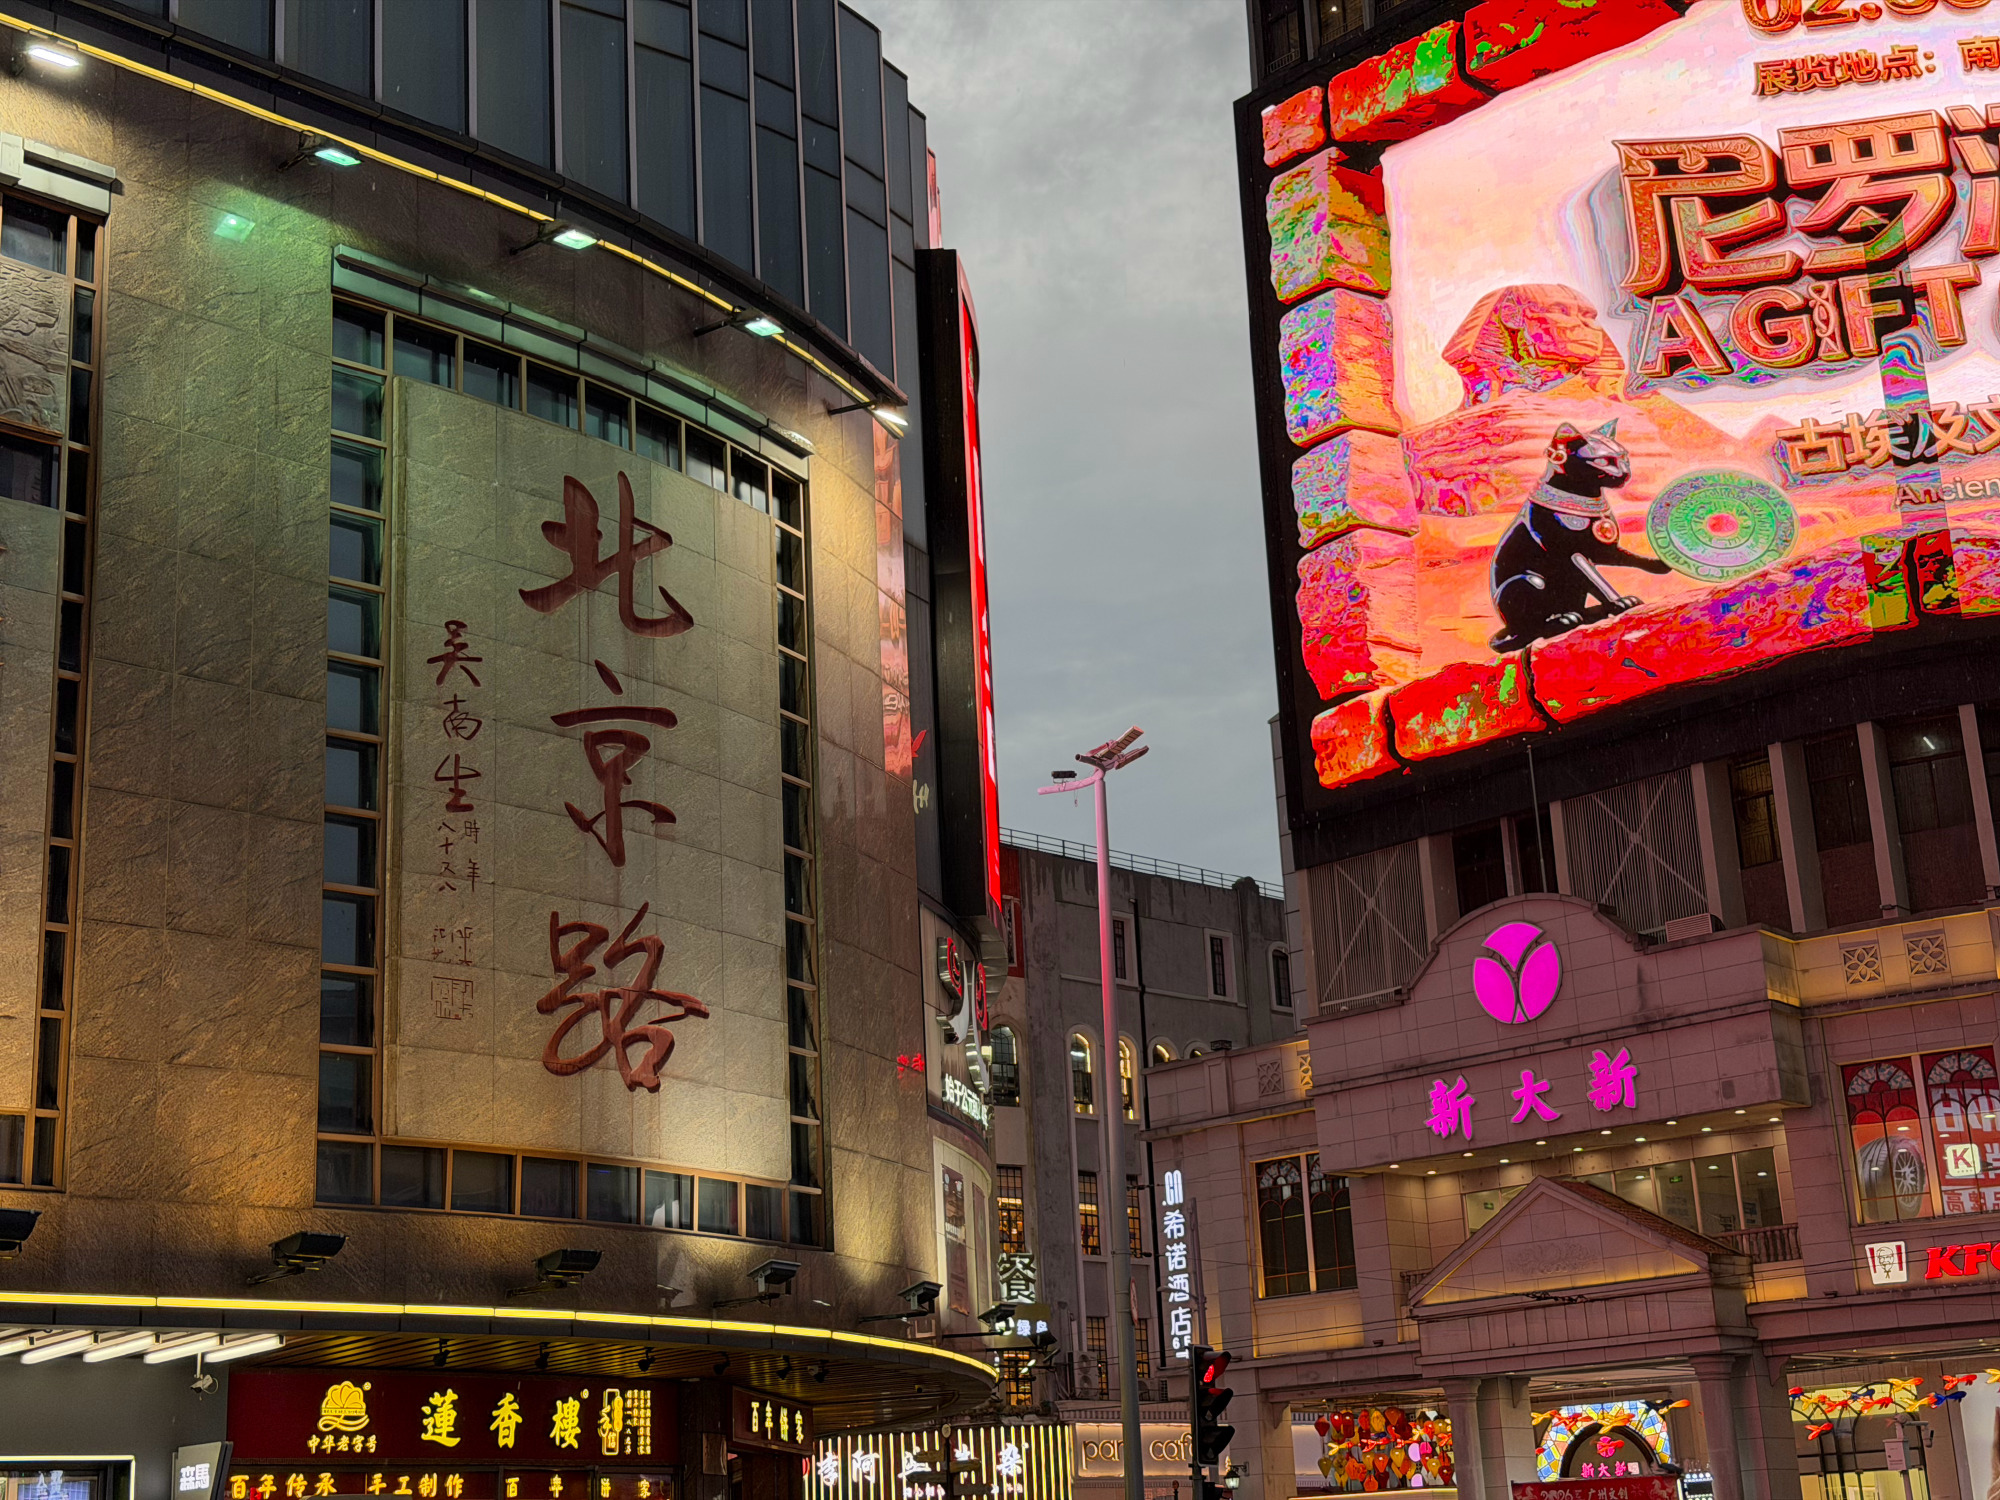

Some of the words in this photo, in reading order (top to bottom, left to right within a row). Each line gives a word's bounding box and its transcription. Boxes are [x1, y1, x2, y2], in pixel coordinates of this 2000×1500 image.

[1637, 295, 1733, 376] A
[1729, 262, 1982, 369] GIFT
[518, 470, 710, 1093] 北京路
[1424, 1047, 1638, 1140] 新大新
[1952, 1148, 1973, 1170] K
[1163, 1209, 1192, 1336] 希诺酒店
[307, 1434, 377, 1454] 中华老字号
[421, 1388, 582, 1449] 蓮香樓
[230, 1472, 337, 1499] 百年传承
[367, 1472, 464, 1498] 手工制作
[1581, 1460, 1627, 1478] 新大新
